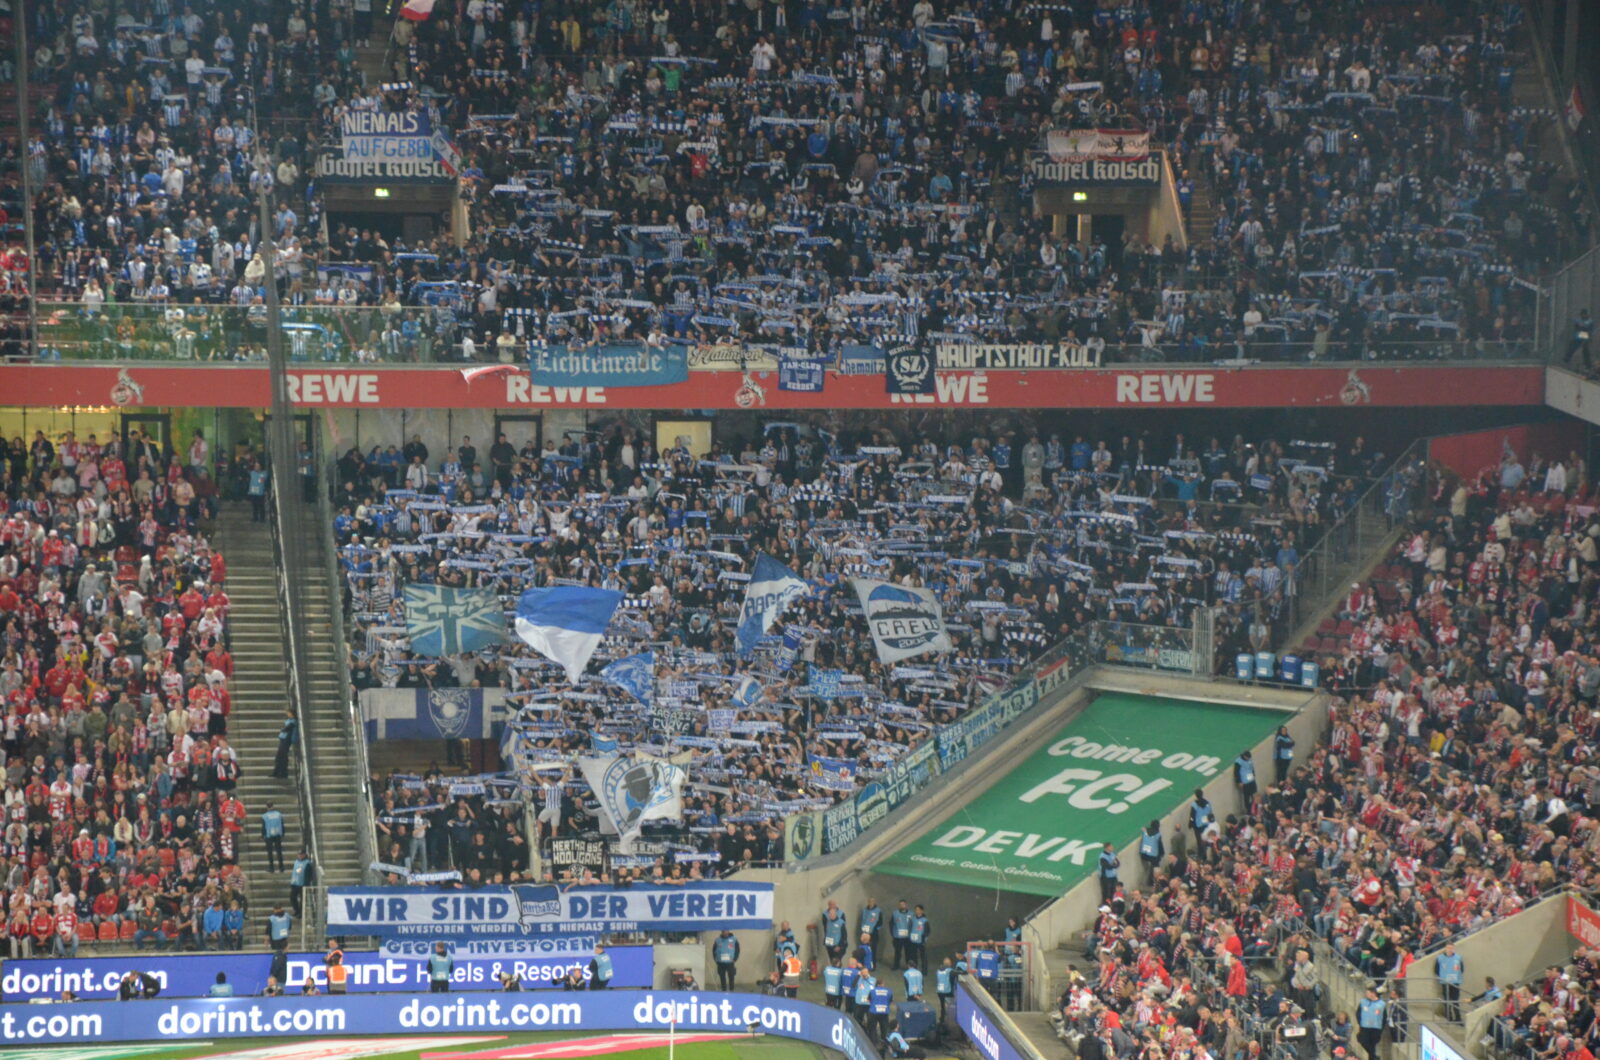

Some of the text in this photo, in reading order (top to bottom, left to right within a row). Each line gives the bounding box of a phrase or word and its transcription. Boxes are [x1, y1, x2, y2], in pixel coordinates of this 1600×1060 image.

[344, 112, 418, 133] NIEMALS
[347, 138, 431, 158] AUFGEBEN
[534, 350, 662, 376] Lichtenrade
[900, 355, 921, 372] SZ
[280, 374, 379, 403] REWE
[1117, 374, 1215, 402] REWE
[876, 618, 941, 636] CREW
[1047, 736, 1221, 777] Come on,
[1018, 768, 1173, 814] FC!
[552, 839, 584, 852] HERTHA
[587, 840, 603, 852] BSC
[553, 851, 603, 865] HOOLIGANS
[931, 825, 1104, 866] DEVK
[910, 854, 1063, 881] Gesagt. Getan. Geholfen.
[345, 896, 509, 922] WIR SIND
[569, 894, 756, 920] DER VEREIN
[398, 921, 637, 934] INVESTOREN WERDEN ES NIEMALS SEIN!
[386, 936, 595, 955] GEGEN INVESTOREN
[158, 1005, 345, 1035] dorint.com
[399, 998, 581, 1028] dorint.com
[633, 995, 800, 1033] dorint.com
[971, 1010, 999, 1058] dorint.com
